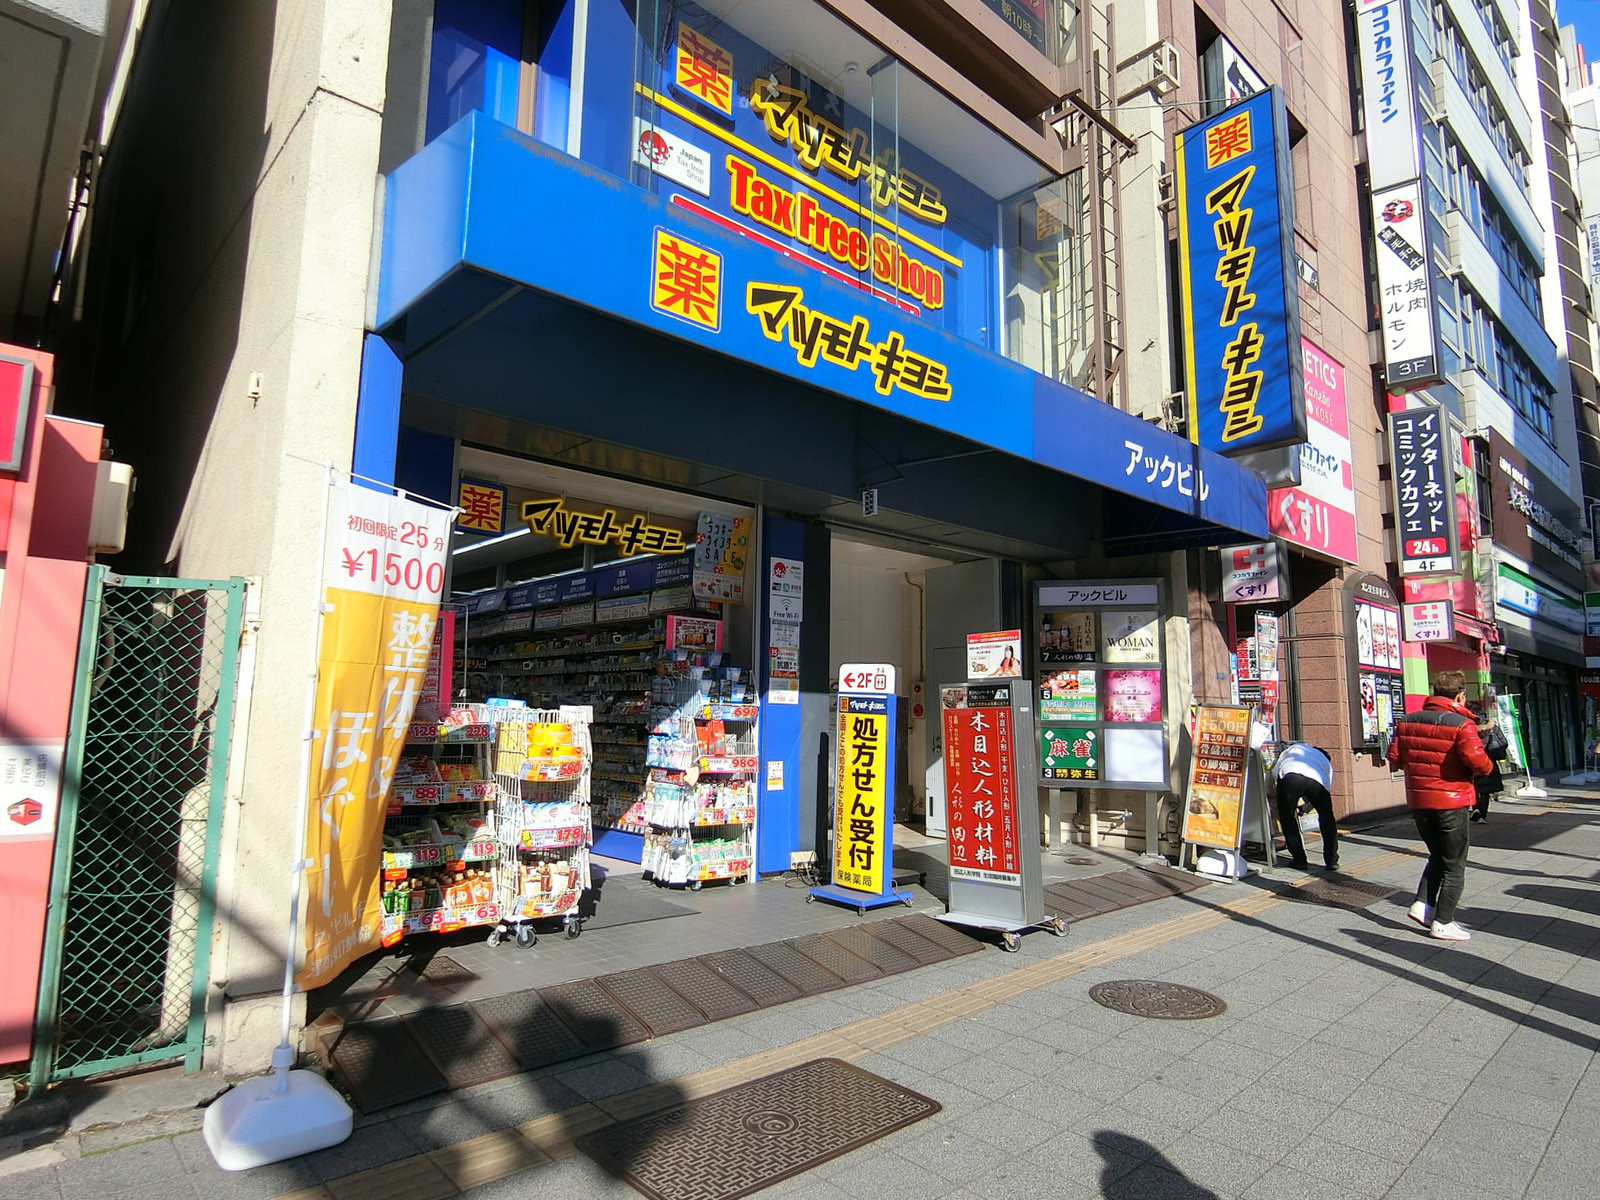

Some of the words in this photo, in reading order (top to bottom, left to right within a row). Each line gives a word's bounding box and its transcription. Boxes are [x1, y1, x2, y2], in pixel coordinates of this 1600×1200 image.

[680, 31, 731, 109] 薬
[1372, 5, 1398, 123] ココカラファイン
[1208, 117, 1248, 166] 薬
[754, 82, 946, 220] マツモトキヨシ
[686, 169, 705, 185] Shop
[729, 158, 796, 235] Tax
[798, 195, 868, 270] Free
[872, 234, 943, 307] Shop
[1381, 227, 1423, 269] 黒毛和牛
[660, 239, 718, 324] 薬
[1406, 278, 1427, 312] 焼肉
[1207, 168, 1263, 441] マツモトキヨシ
[1386, 284, 1406, 350] ホルモン
[749, 284, 950, 398] マツモトキヨシ
[1399, 361, 1427, 376] 3F
[1304, 380, 1331, 408] Kanebo
[1315, 404, 1334, 427] KOSÉ
[1125, 440, 1209, 502] アックビル
[1396, 419, 1422, 532] コミックカフェ
[1418, 414, 1443, 532] インターネット
[461, 486, 502, 531] 薬
[523, 500, 687, 554] マツモトキヨシ
[1280, 492, 1329, 549] くすり
[1413, 540, 1438, 555] 24h
[705, 548, 736, 563] SALE
[341, 547, 443, 593] ¥1500
[1419, 560, 1436, 572] 4F
[1068, 590, 1127, 602] アックビル
[1235, 583, 1267, 597] くすり
[774, 611, 786, 619] Free
[1107, 637, 1154, 647] WOMAN
[1415, 630, 1440, 639] くすり
[1042, 653, 1050, 661] 7
[857, 673, 873, 688] 2F
[1043, 691, 1050, 699] 5
[734, 707, 759, 718] 698
[849, 701, 885, 711] マツモトキヨシ
[413, 726, 438, 738] 128
[466, 726, 489, 738] 228
[1200, 719, 1247, 733] 1500円
[1202, 733, 1222, 742] 肩こり
[1049, 739, 1092, 757] 麻雀
[1199, 744, 1242, 758] 骨盤矯正
[559, 762, 581, 776] 580
[731, 758, 756, 768] 980
[1045, 768, 1052, 778] 3
[1070, 769, 1096, 779] 弥生
[415, 786, 438, 799] 88
[849, 717, 878, 871] 処方せん受付
[968, 711, 998, 868] 木目込人形材料
[557, 828, 581, 842] 178
[415, 848, 440, 862] 119
[472, 841, 495, 856] 119
[728, 860, 749, 871] 178
[837, 870, 872, 887] 保険薬局
[420, 912, 444, 926] 63
[476, 905, 499, 919] 63
